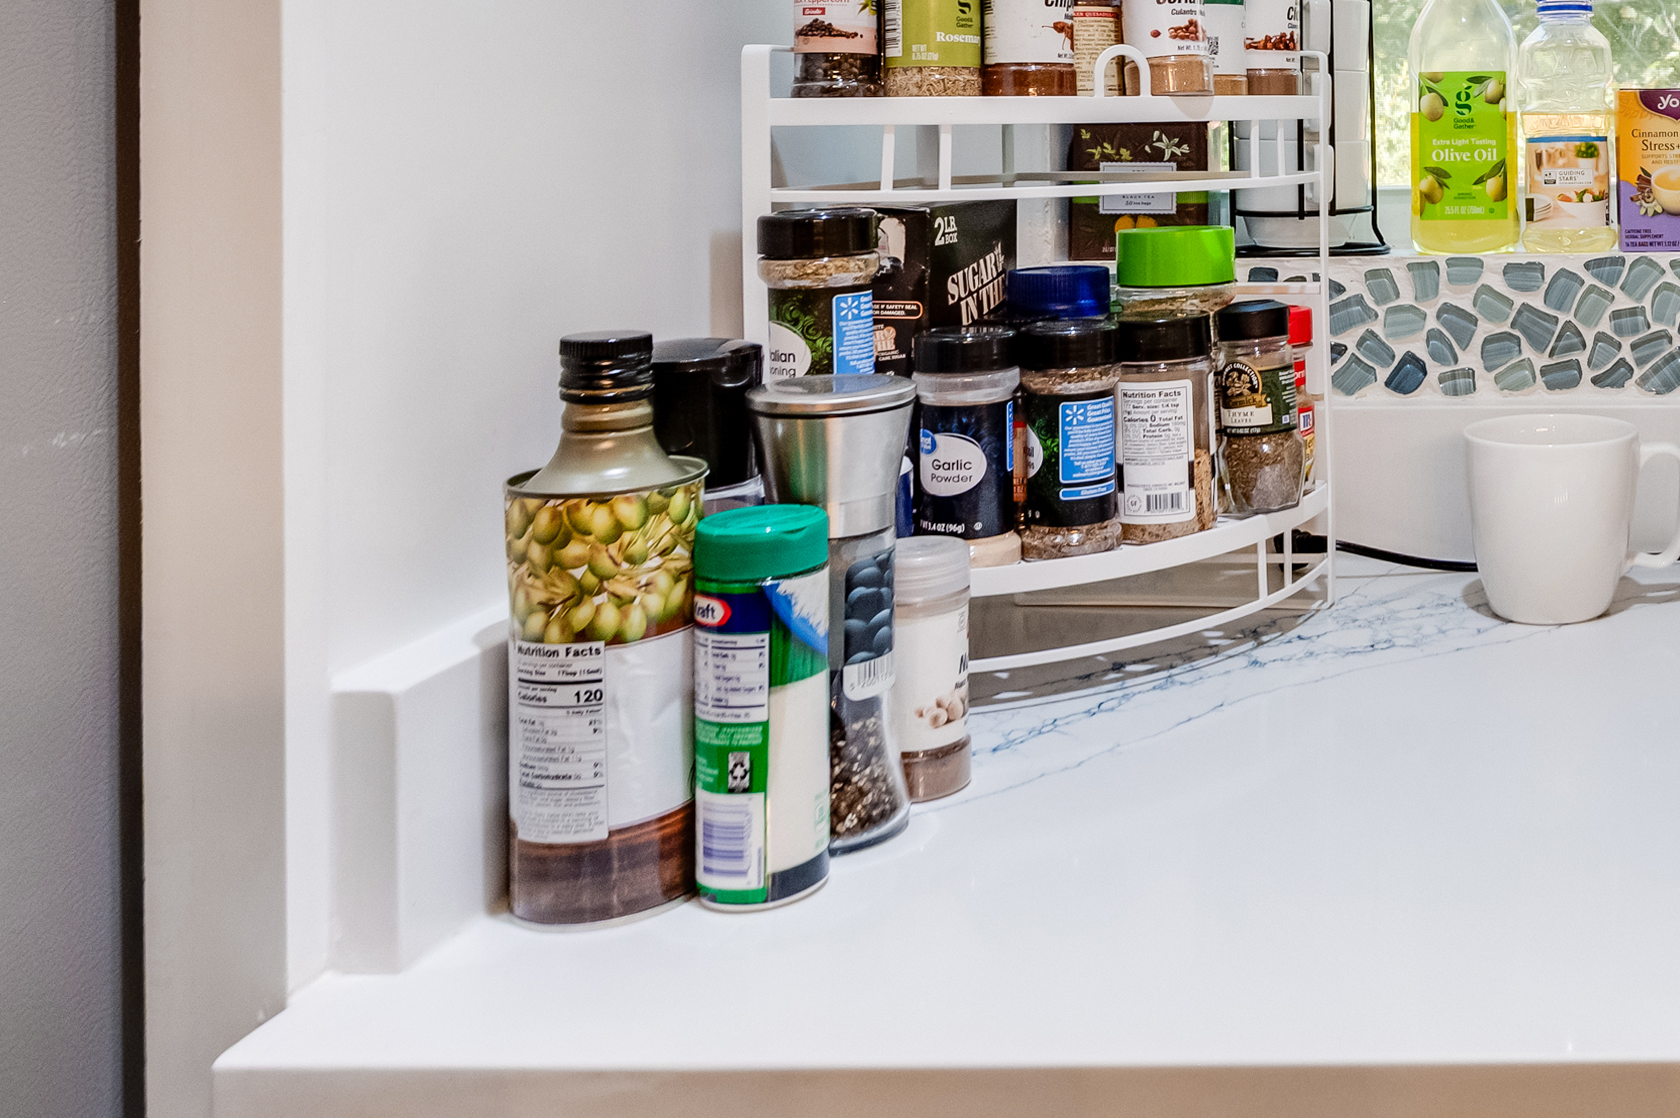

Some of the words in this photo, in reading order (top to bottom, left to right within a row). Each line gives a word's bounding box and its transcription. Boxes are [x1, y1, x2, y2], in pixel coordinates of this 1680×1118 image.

[1631, 129, 1679, 138] Cinnamon
[1451, 138, 1469, 147] Light
[1470, 138, 1496, 147] Tasting
[1431, 148, 1471, 162] Olive
[1473, 148, 1498, 163] Oil
[1444, 206, 1454, 214] 25.5
[1460, 206, 1466, 214] OZ
[934, 216, 945, 246] 2
[945, 233, 958, 244] BOX
[947, 250, 1002, 306] SUGAR
[960, 292, 978, 326] IN
[770, 349, 796, 363] alian
[770, 367, 796, 379] oning
[1158, 390, 1182, 398] Facts
[1227, 410, 1255, 418] THYME
[931, 459, 973, 471] Garlic
[930, 473, 973, 483] Powder
[937, 522, 945, 531] OZ
[946, 523, 966, 533] (96g)
[516, 645, 560, 658] Nutrition
[565, 645, 602, 657] Facts
[518, 692, 547, 703] Calories
[574, 689, 603, 704] 120
